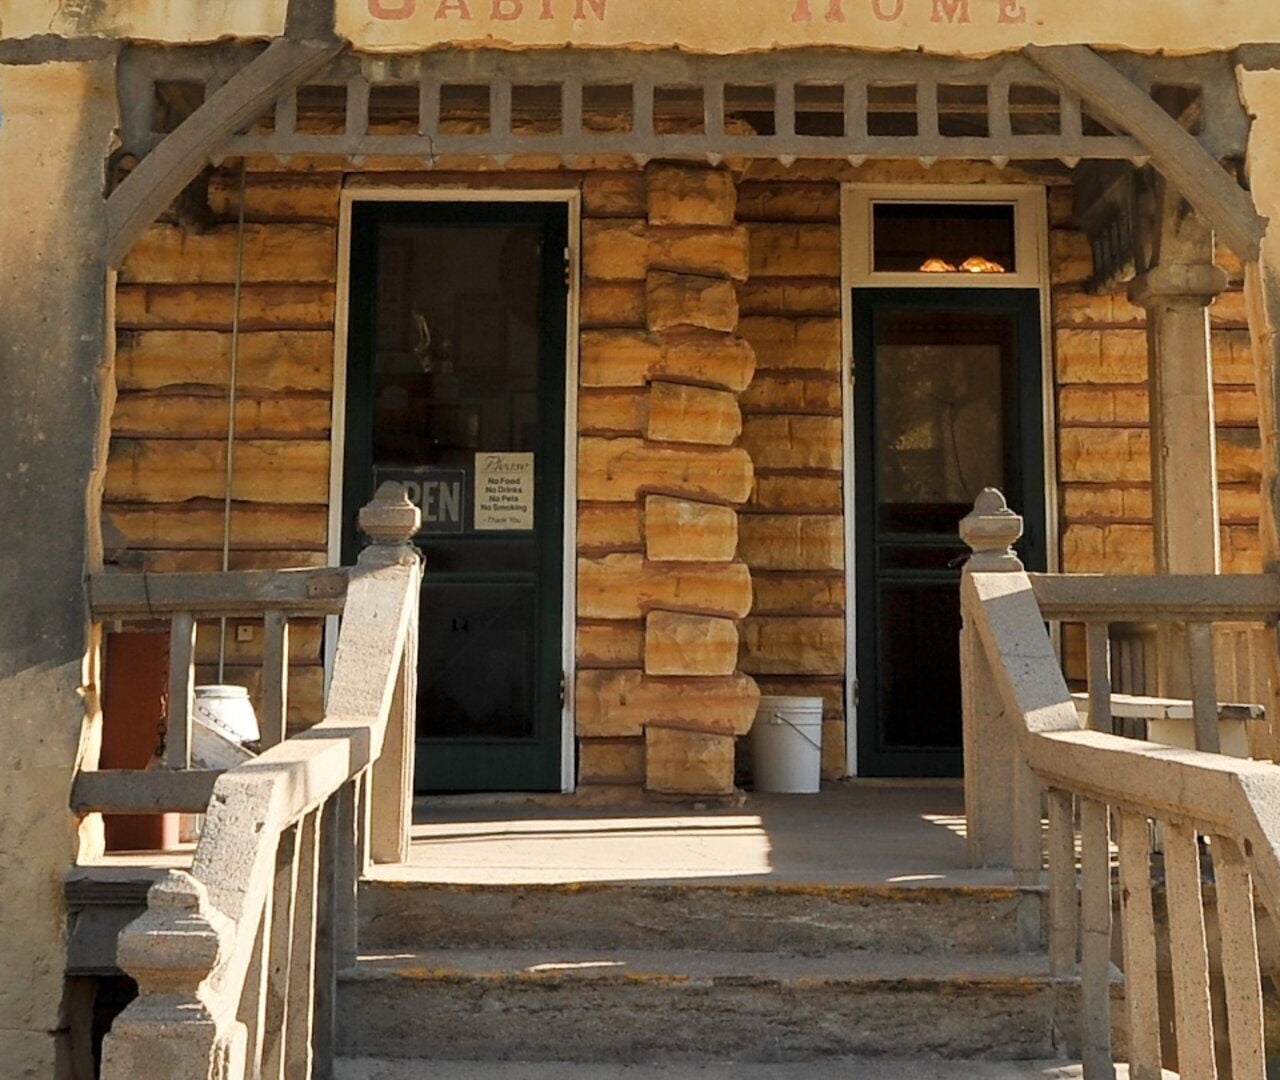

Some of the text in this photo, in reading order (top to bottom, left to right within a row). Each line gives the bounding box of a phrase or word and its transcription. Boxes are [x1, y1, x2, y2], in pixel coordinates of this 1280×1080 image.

[484, 455, 529, 471] Please
[488, 476, 521, 485] No Food
[498, 486, 523, 494] Drinks
[489, 495, 519, 503] No Pets
[493, 503, 528, 513] Smoking
